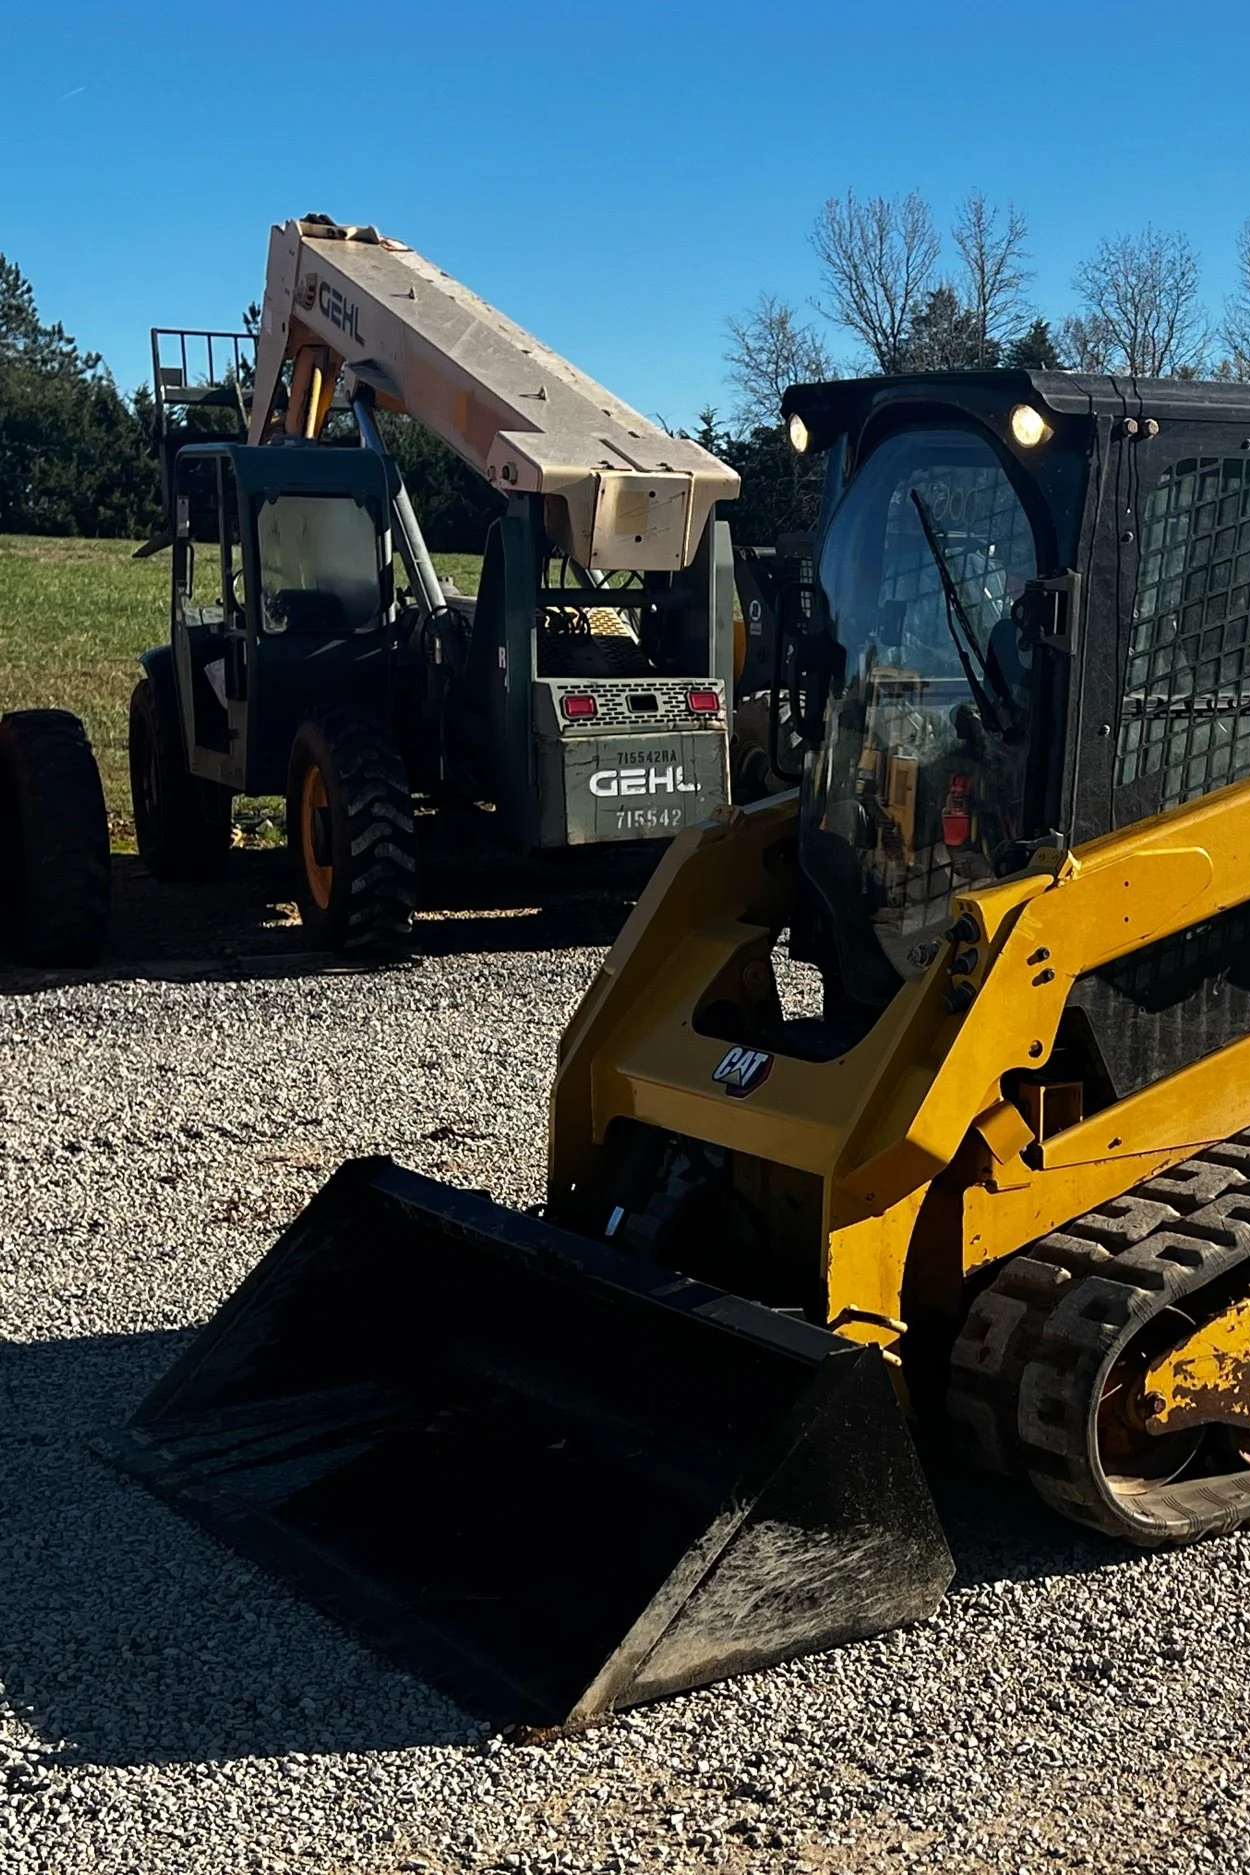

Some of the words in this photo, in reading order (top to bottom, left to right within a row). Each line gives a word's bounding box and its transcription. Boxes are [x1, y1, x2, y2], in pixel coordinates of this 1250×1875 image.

[319, 280, 365, 348] GEHL
[589, 765, 702, 797] GEHL
[616, 808, 682, 829] 715542
[713, 1046, 769, 1087] CAT
